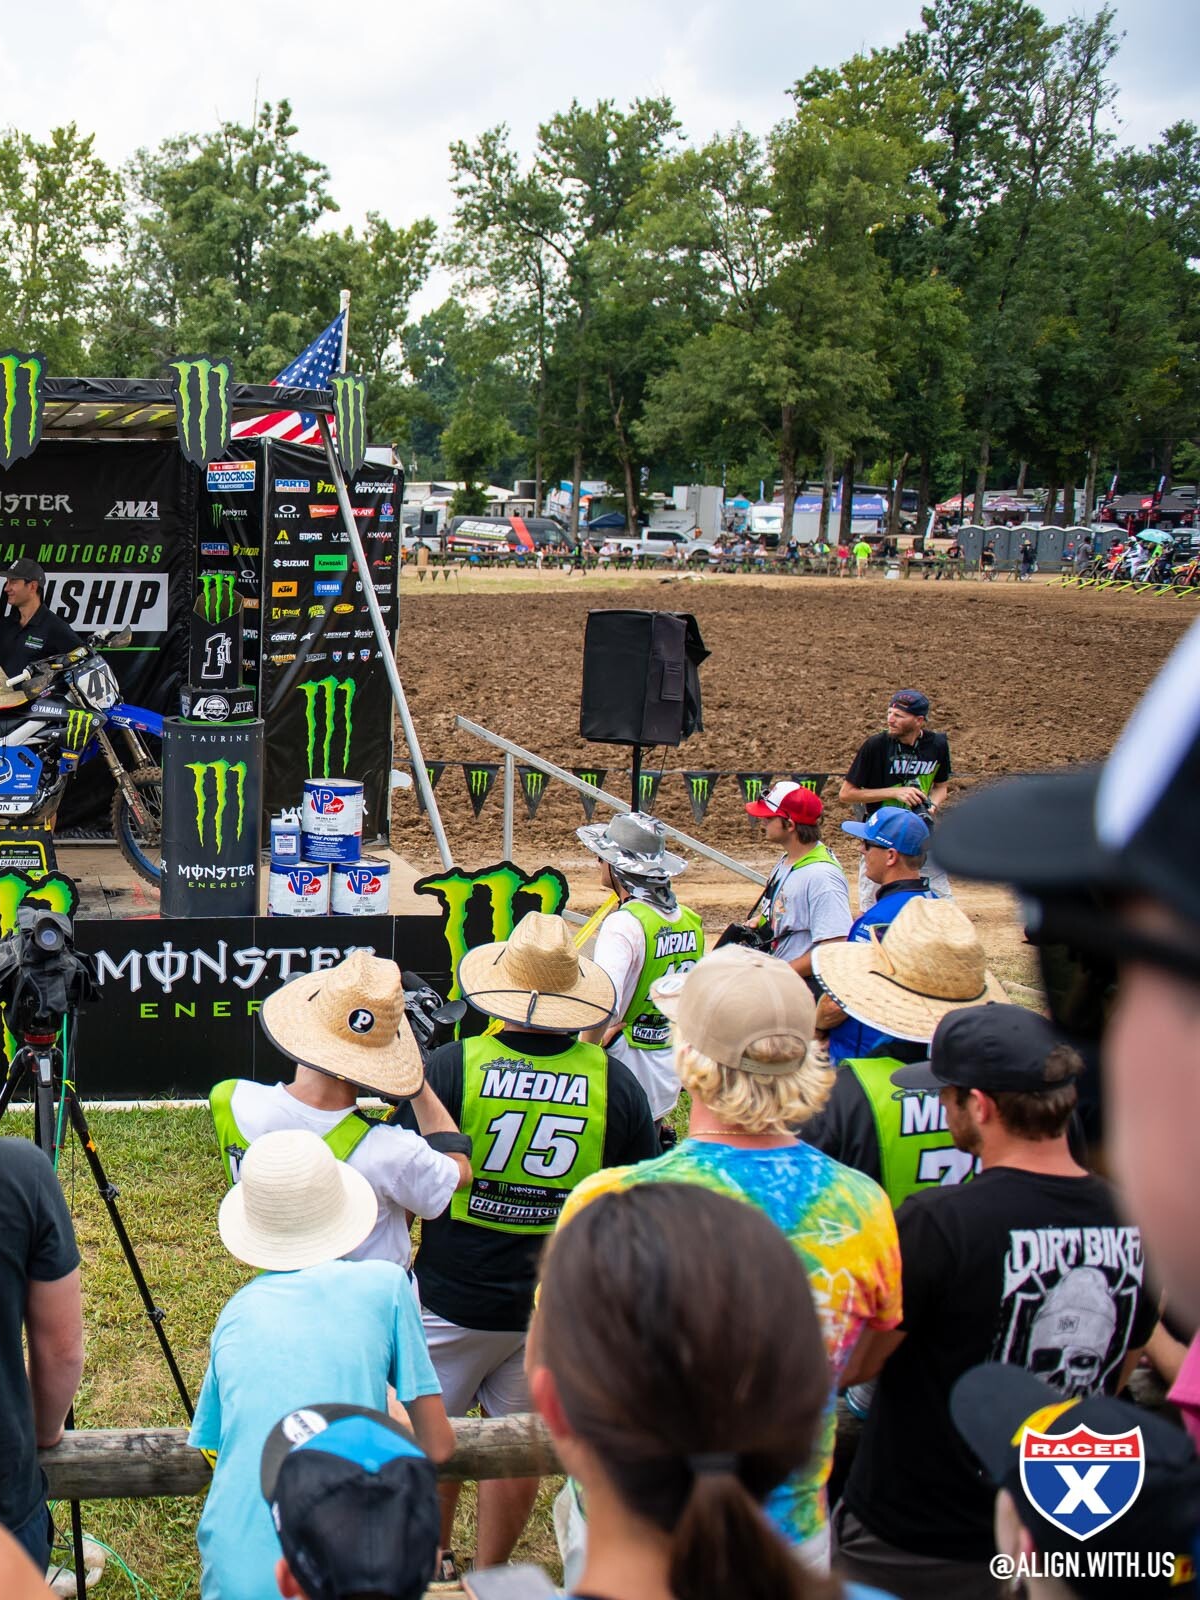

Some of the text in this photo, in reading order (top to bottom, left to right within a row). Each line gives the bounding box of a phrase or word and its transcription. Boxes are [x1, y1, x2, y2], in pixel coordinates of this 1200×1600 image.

[208, 471, 255, 482] MOTOCROSS
[275, 480, 310, 488] PARTS
[104, 500, 160, 518] AMA
[38, 544, 163, 563] MOTOCROSS
[38, 705, 63, 715] YAMAHA
[190, 734, 249, 743] TAURINE
[311, 788, 335, 815] VP
[178, 863, 255, 881] MONSTER
[188, 881, 246, 889] ENERGY
[288, 870, 314, 896] VP
[347, 869, 373, 896] VP
[352, 1011, 372, 1029] P
[480, 1068, 589, 1107] MEDIA
[480, 1110, 589, 1179] 15
